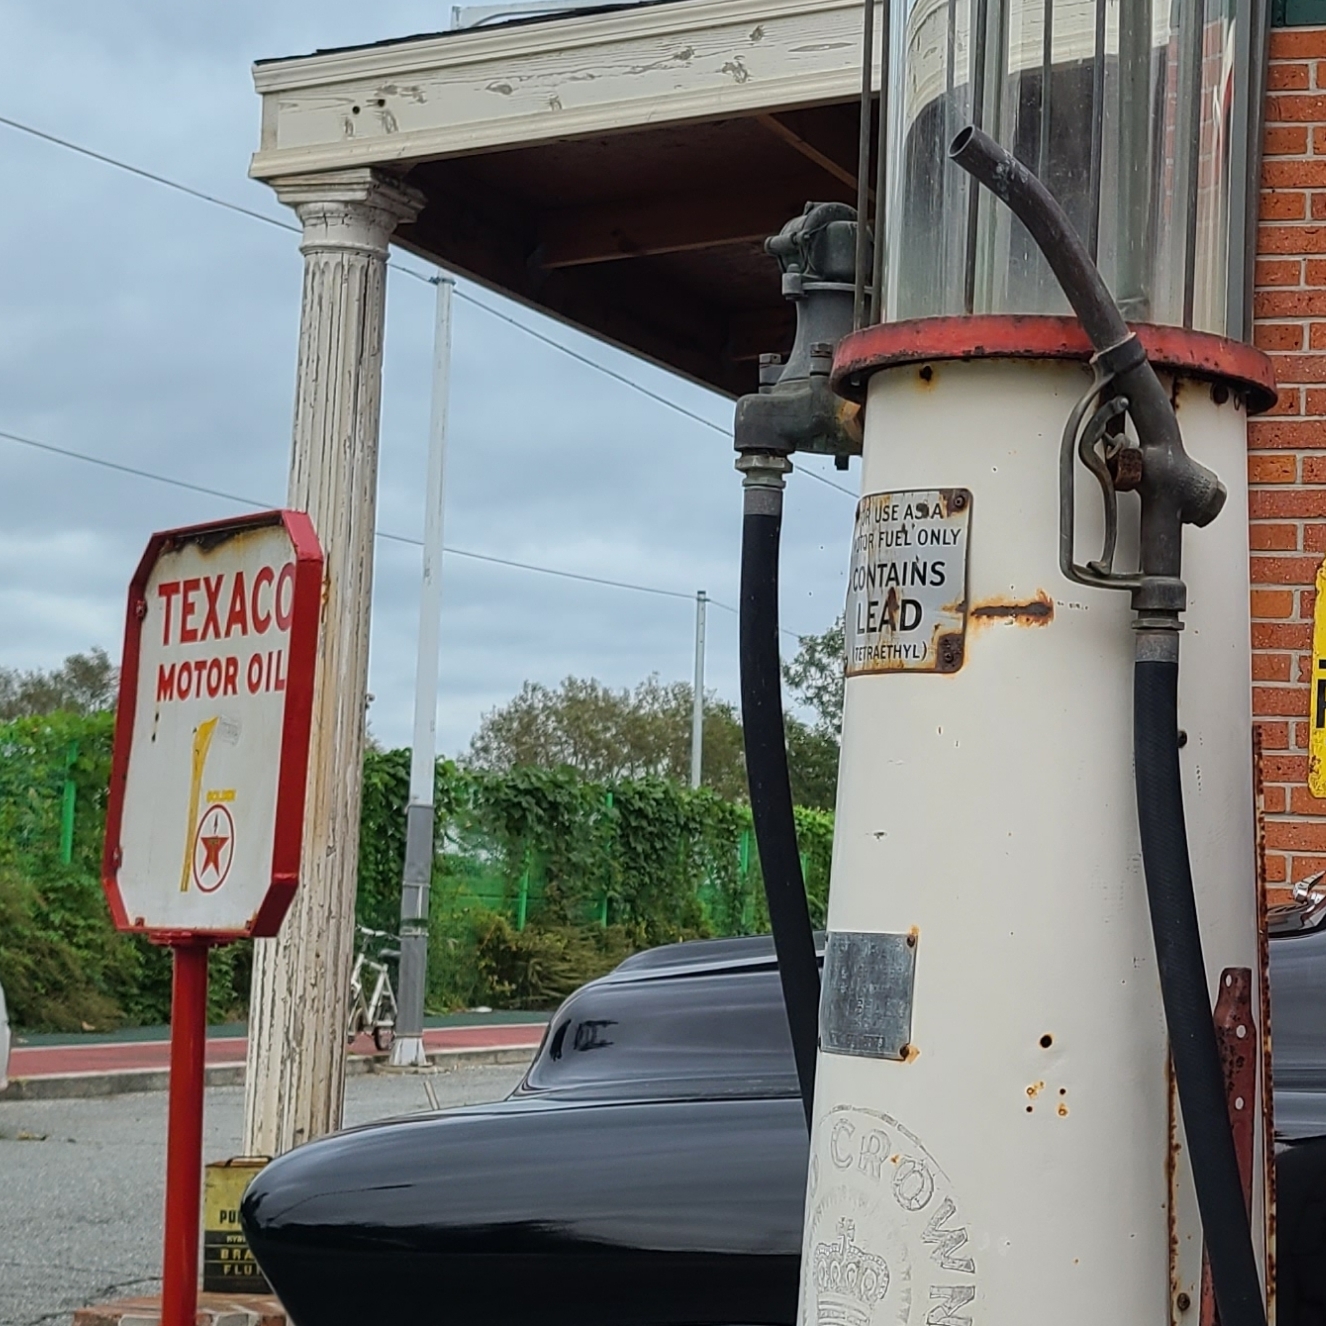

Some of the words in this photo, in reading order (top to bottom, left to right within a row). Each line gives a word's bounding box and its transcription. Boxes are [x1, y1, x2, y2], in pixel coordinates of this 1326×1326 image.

[875, 504, 899, 524] USE
[931, 503, 944, 519] A
[878, 528, 912, 548] FUEL
[917, 528, 962, 546] ONLY
[853, 561, 946, 592] CONTAINS
[158, 562, 296, 646] TEXACO
[857, 598, 922, 635] LEAD
[852, 641, 927, 663] (TETRAETHYL)
[156, 656, 239, 702] MOTOR
[247, 650, 286, 694] OIL
